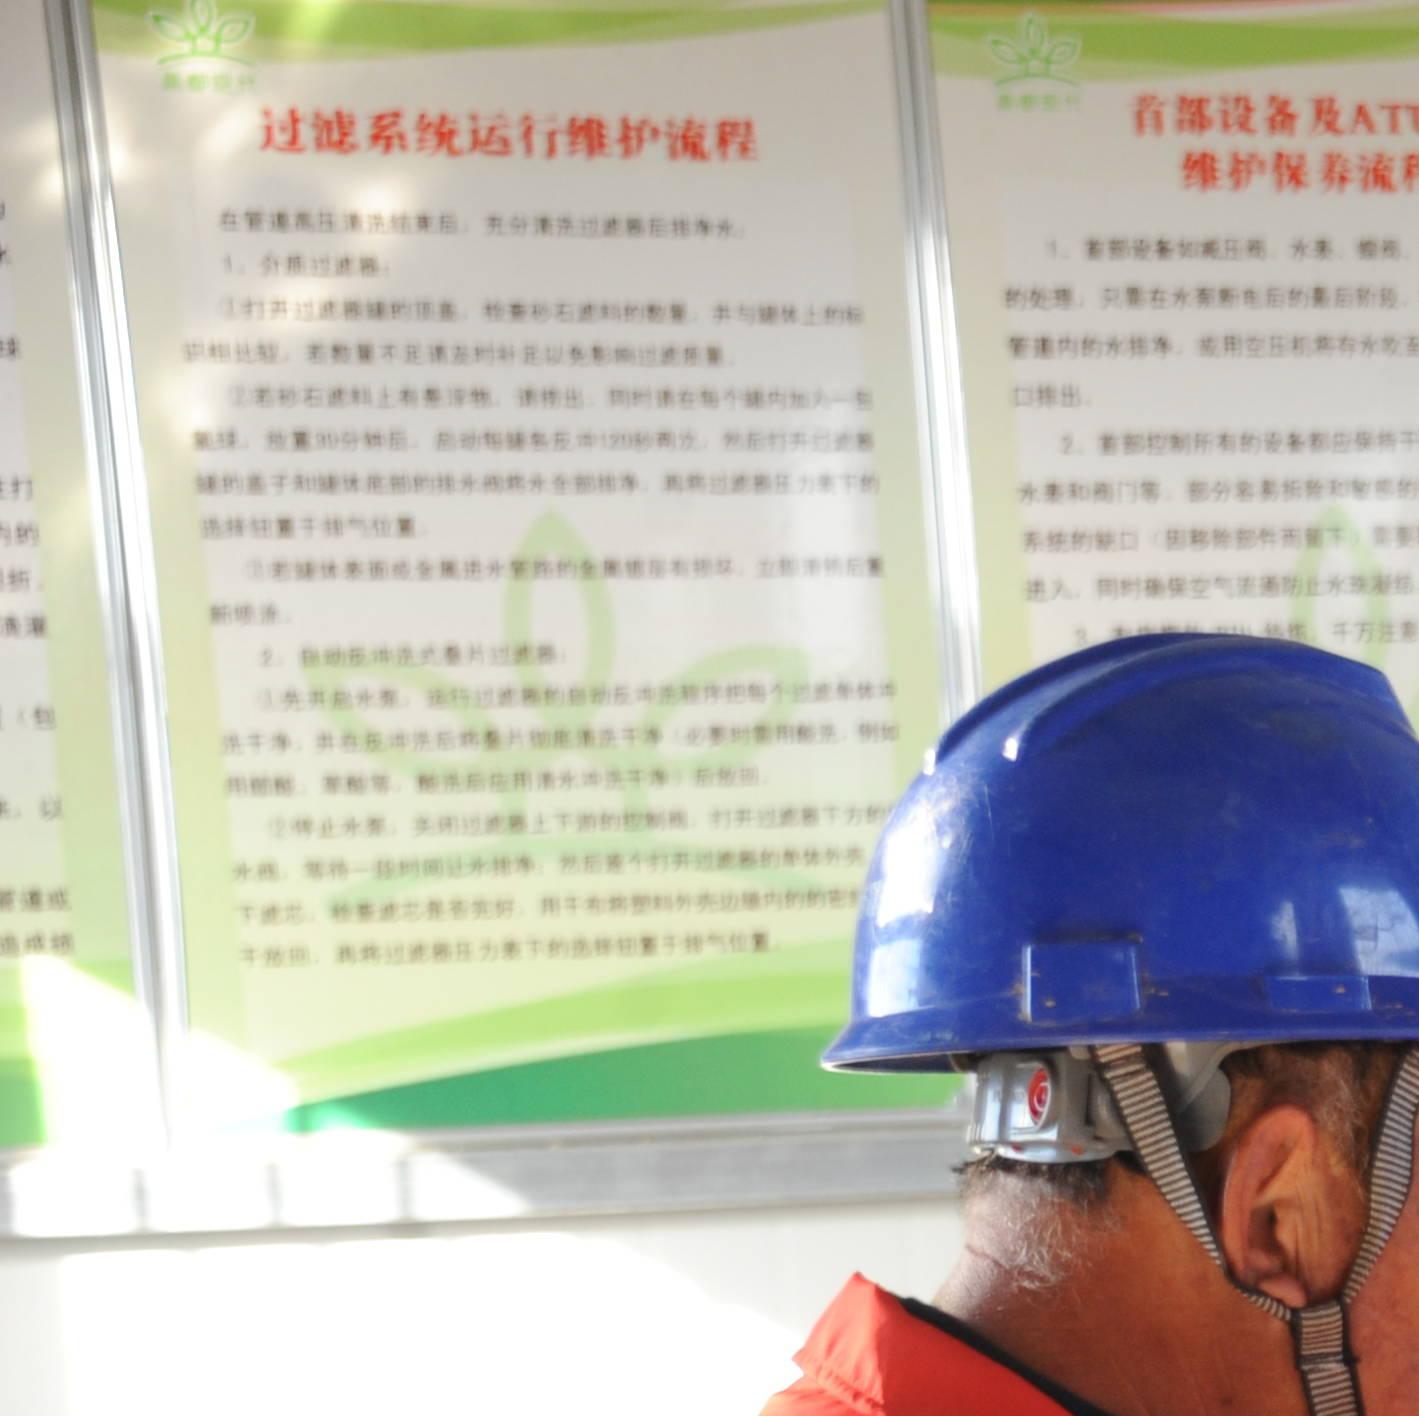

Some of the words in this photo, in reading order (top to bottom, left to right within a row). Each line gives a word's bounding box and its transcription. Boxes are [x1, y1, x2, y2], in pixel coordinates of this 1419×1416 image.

[260, 107, 760, 164] 过滤系统运行维护流程
